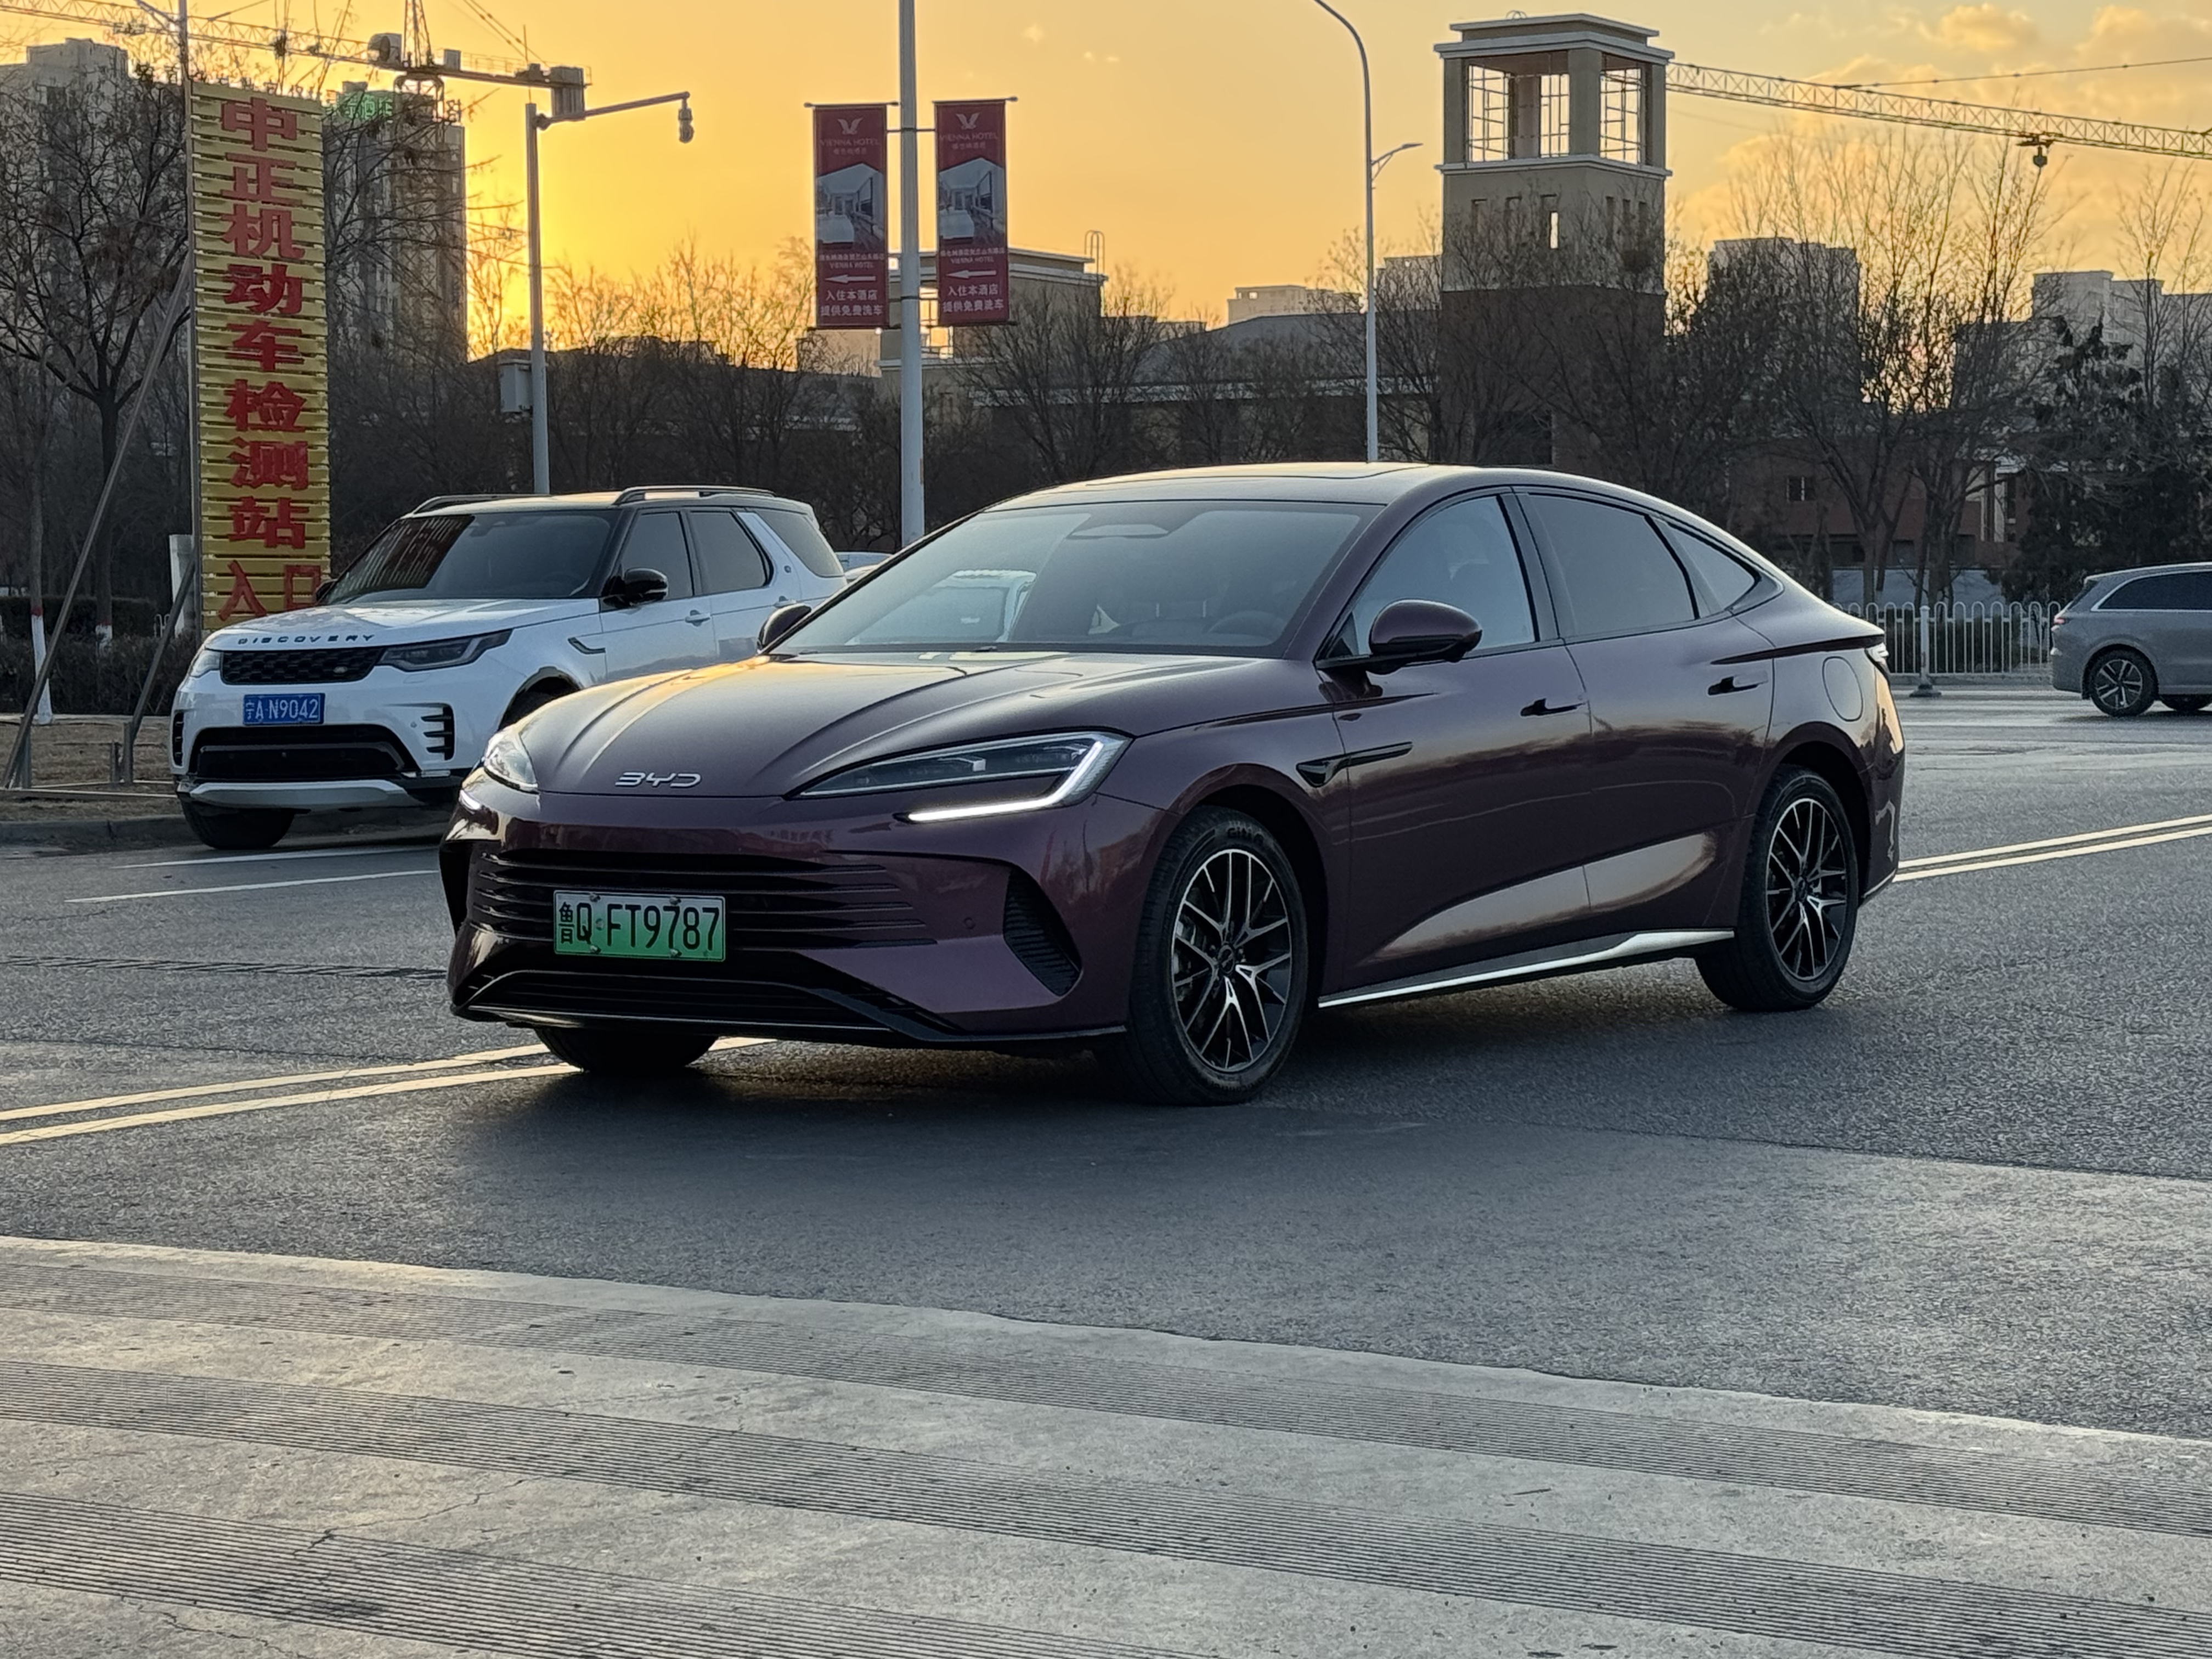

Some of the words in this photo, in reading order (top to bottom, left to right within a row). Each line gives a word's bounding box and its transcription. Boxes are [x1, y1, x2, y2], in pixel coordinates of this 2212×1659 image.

[854, 138, 879, 146] HOTEL
[972, 132, 998, 140] HOTEL
[826, 289, 877, 301] 入住本酒店
[948, 283, 998, 297] 入住本酒店
[221, 97, 309, 549] 中正机动车检测站
[218, 560, 321, 622] 入口
[238, 634, 375, 645] DISCOVERY
[615, 772, 702, 788] BYD
